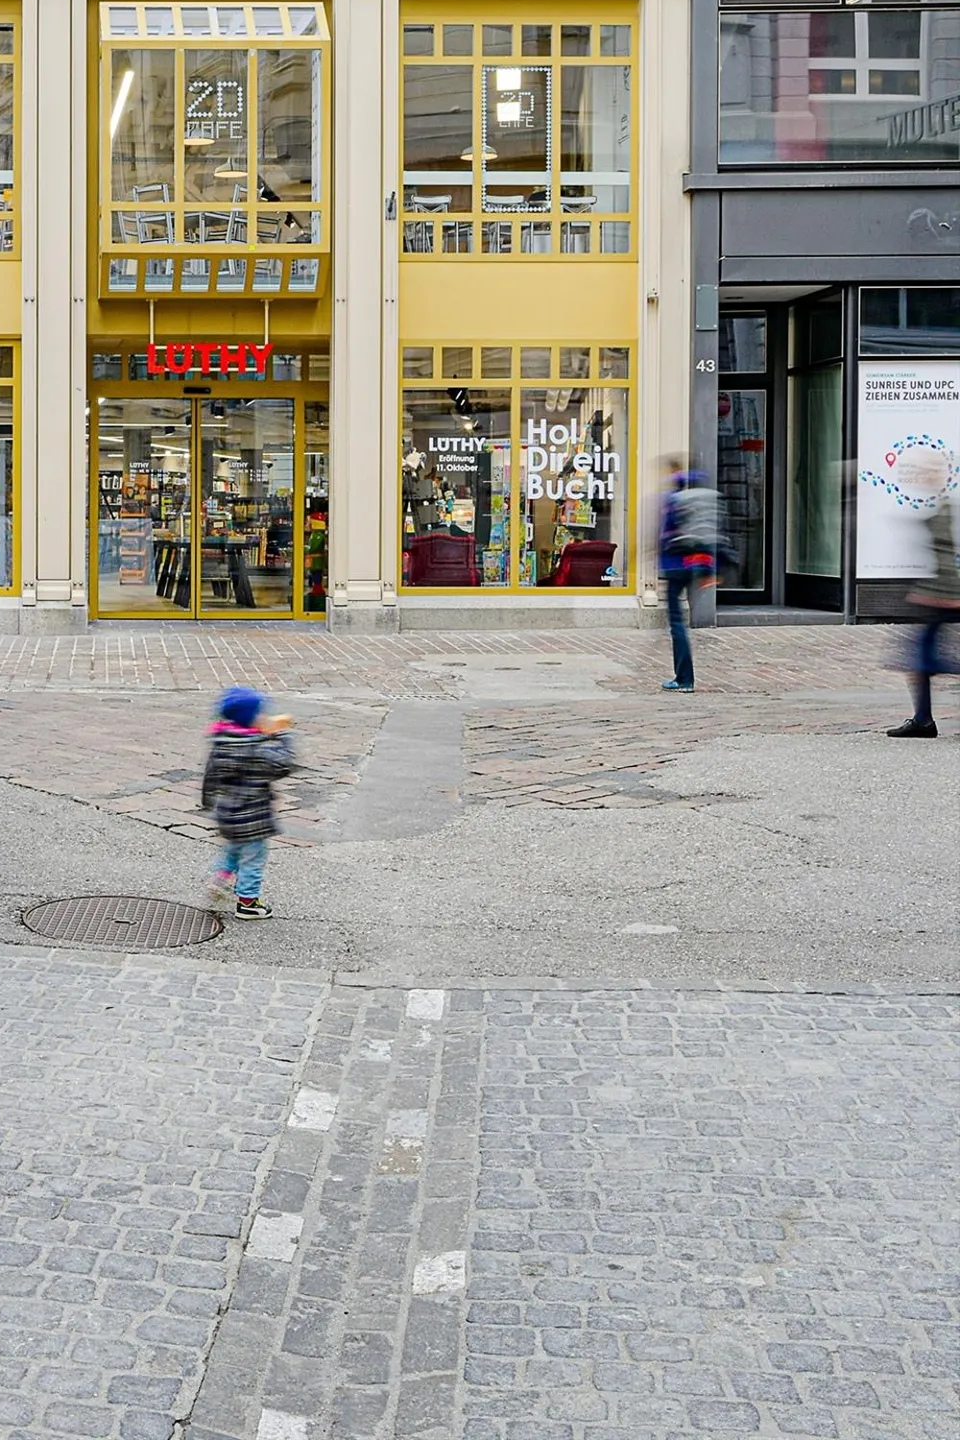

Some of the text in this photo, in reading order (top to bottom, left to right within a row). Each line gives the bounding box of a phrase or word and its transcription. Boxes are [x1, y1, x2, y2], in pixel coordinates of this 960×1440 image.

[187, 81, 243, 118] 2D
[147, 343, 273, 374] LÜTHY
[696, 360, 716, 372] 43
[866, 381, 955, 389] SUNRISE UND UPC
[866, 392, 959, 400] ZIEHEN ZUSAMMEN
[528, 418, 577, 445] Hol
[429, 437, 486, 452] LÜTHY
[438, 454, 475, 464] Eröffnung
[528, 445, 620, 473] Dir ein
[436, 463, 478, 472] 11. Oktober
[528, 473, 614, 500] Buch!
